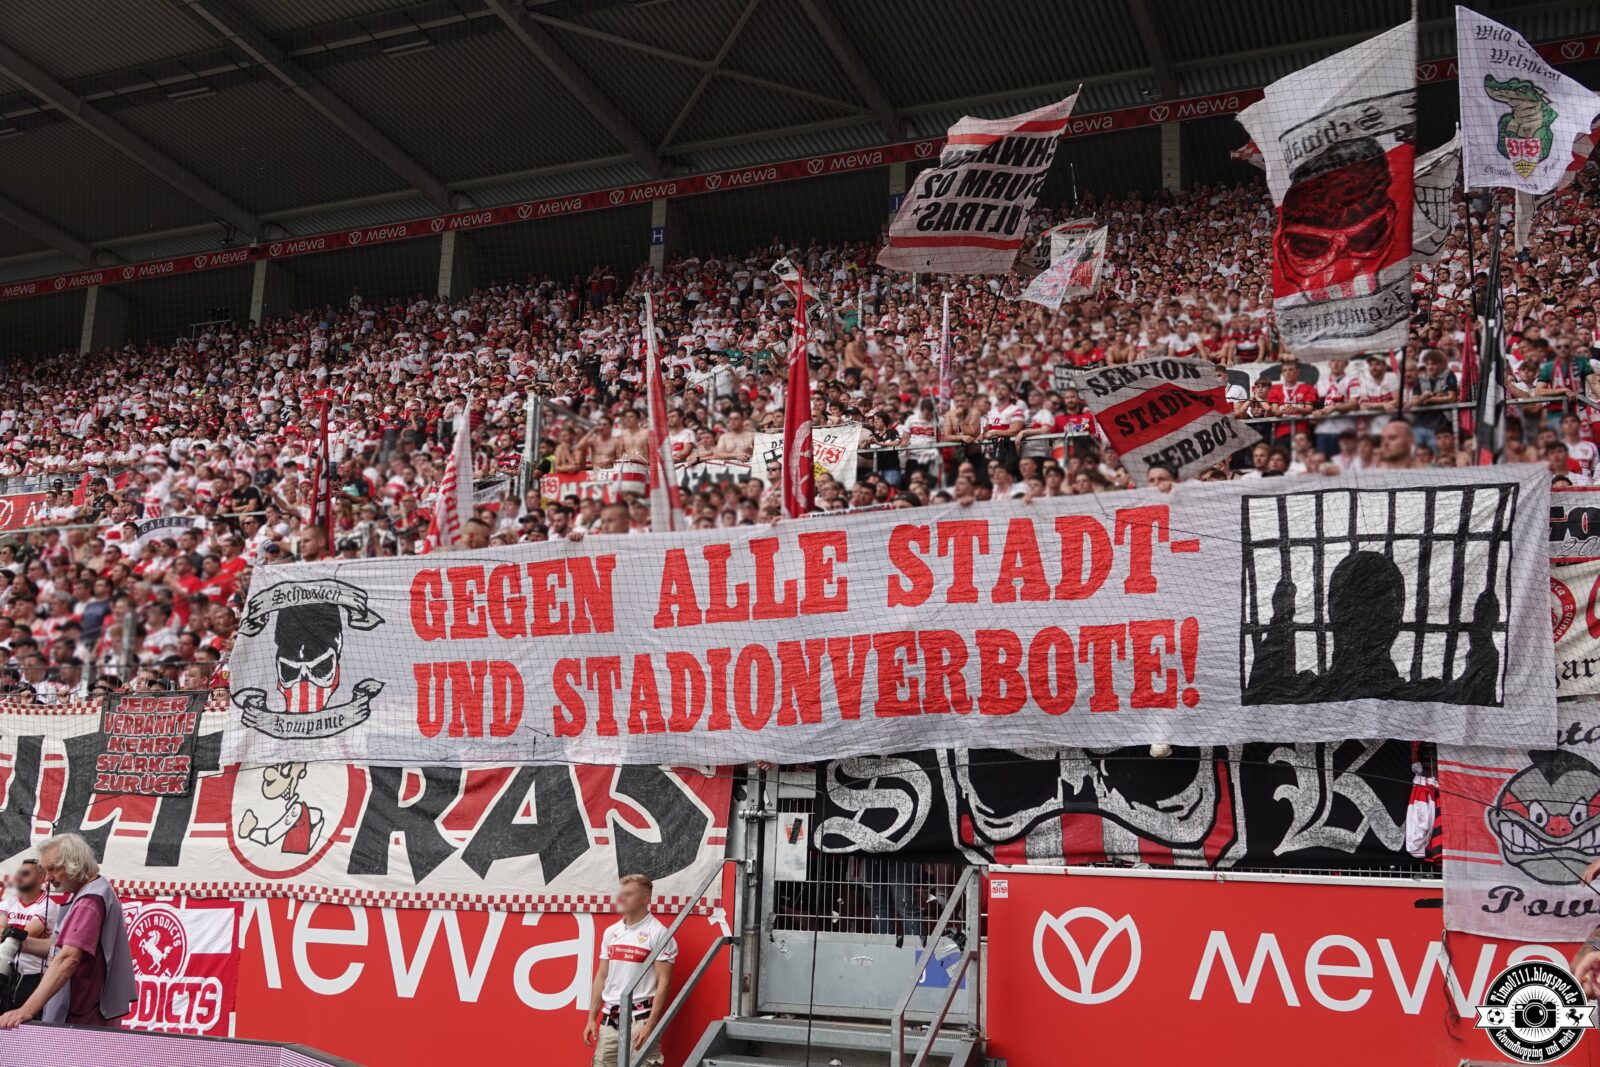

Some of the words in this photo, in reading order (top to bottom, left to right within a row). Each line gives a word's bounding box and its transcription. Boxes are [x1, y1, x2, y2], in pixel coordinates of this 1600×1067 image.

[1475, 25, 1512, 42] Wild
[652, 229, 664, 243] H
[409, 554, 616, 642] GEGEN
[653, 530, 849, 629] ALLE
[887, 504, 1200, 608] STADT-
[413, 660, 525, 738] UND
[552, 616, 1200, 738] STADIONVERBOTE!
[116, 696, 190, 713] JEDER
[104, 711, 197, 736] VERBANNTE
[107, 735, 184, 754] KEHRT
[94, 772, 187, 794] ZURÜCK
[135, 917, 152, 938] 0711
[153, 915, 182, 947] ADDICTS
